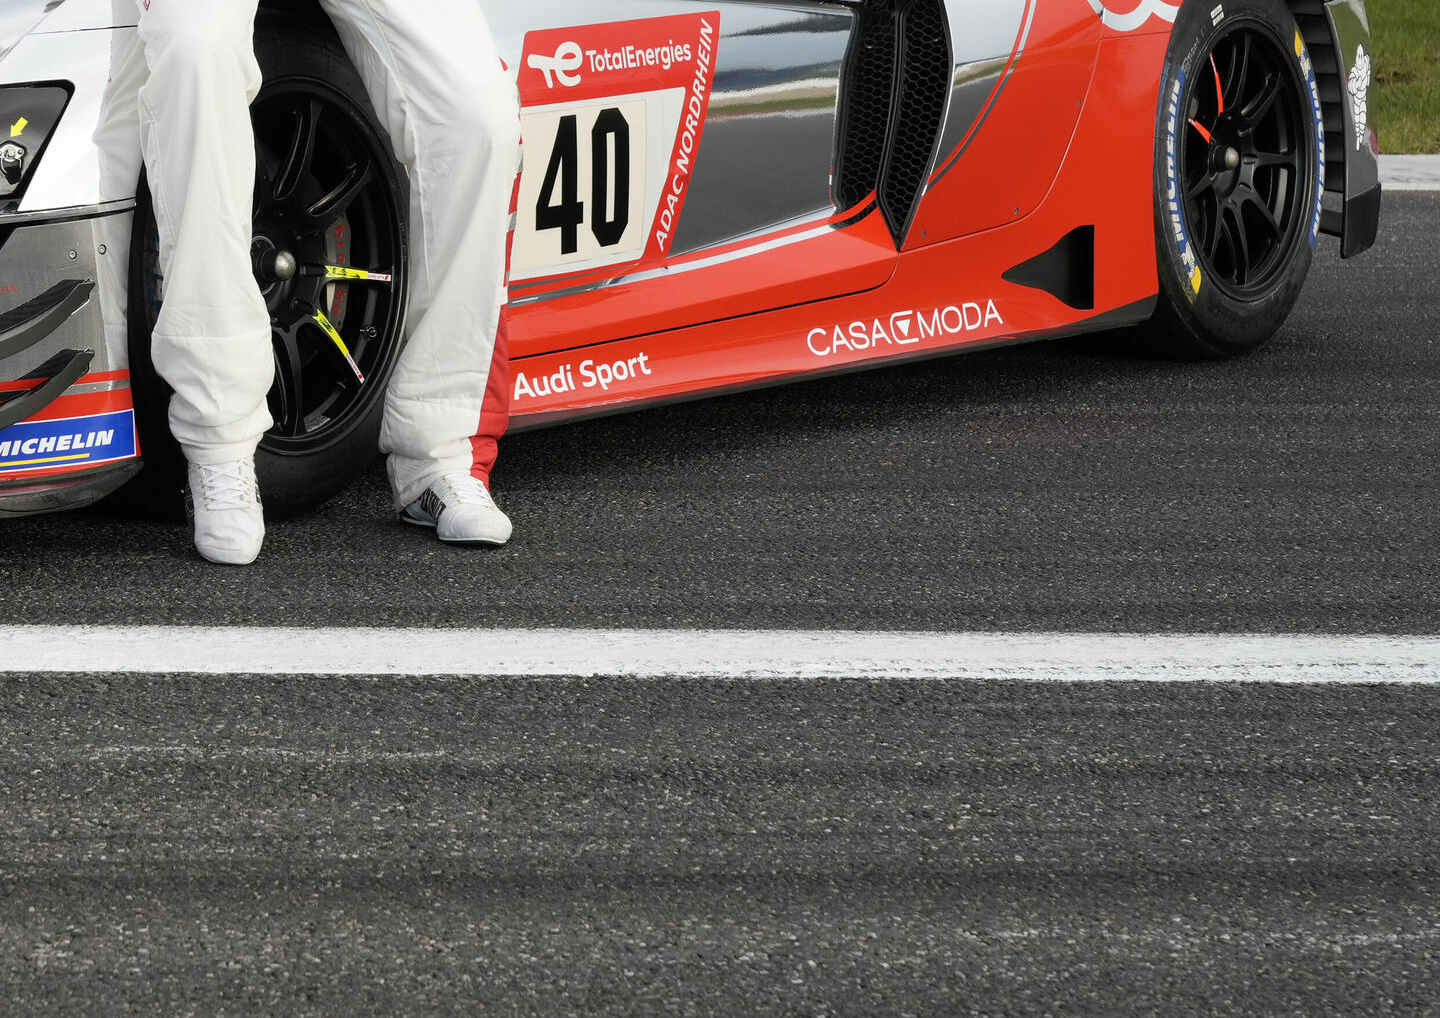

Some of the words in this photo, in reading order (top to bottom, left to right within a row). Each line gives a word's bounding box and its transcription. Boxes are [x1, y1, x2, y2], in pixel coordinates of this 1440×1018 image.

[585, 40, 692, 73] TotalEnergies
[535, 107, 630, 255] 40
[656, 174, 683, 252] ADAC
[676, 18, 713, 174] NORDRHEIN
[513, 362, 574, 400] Audi
[579, 351, 652, 394] Sport
